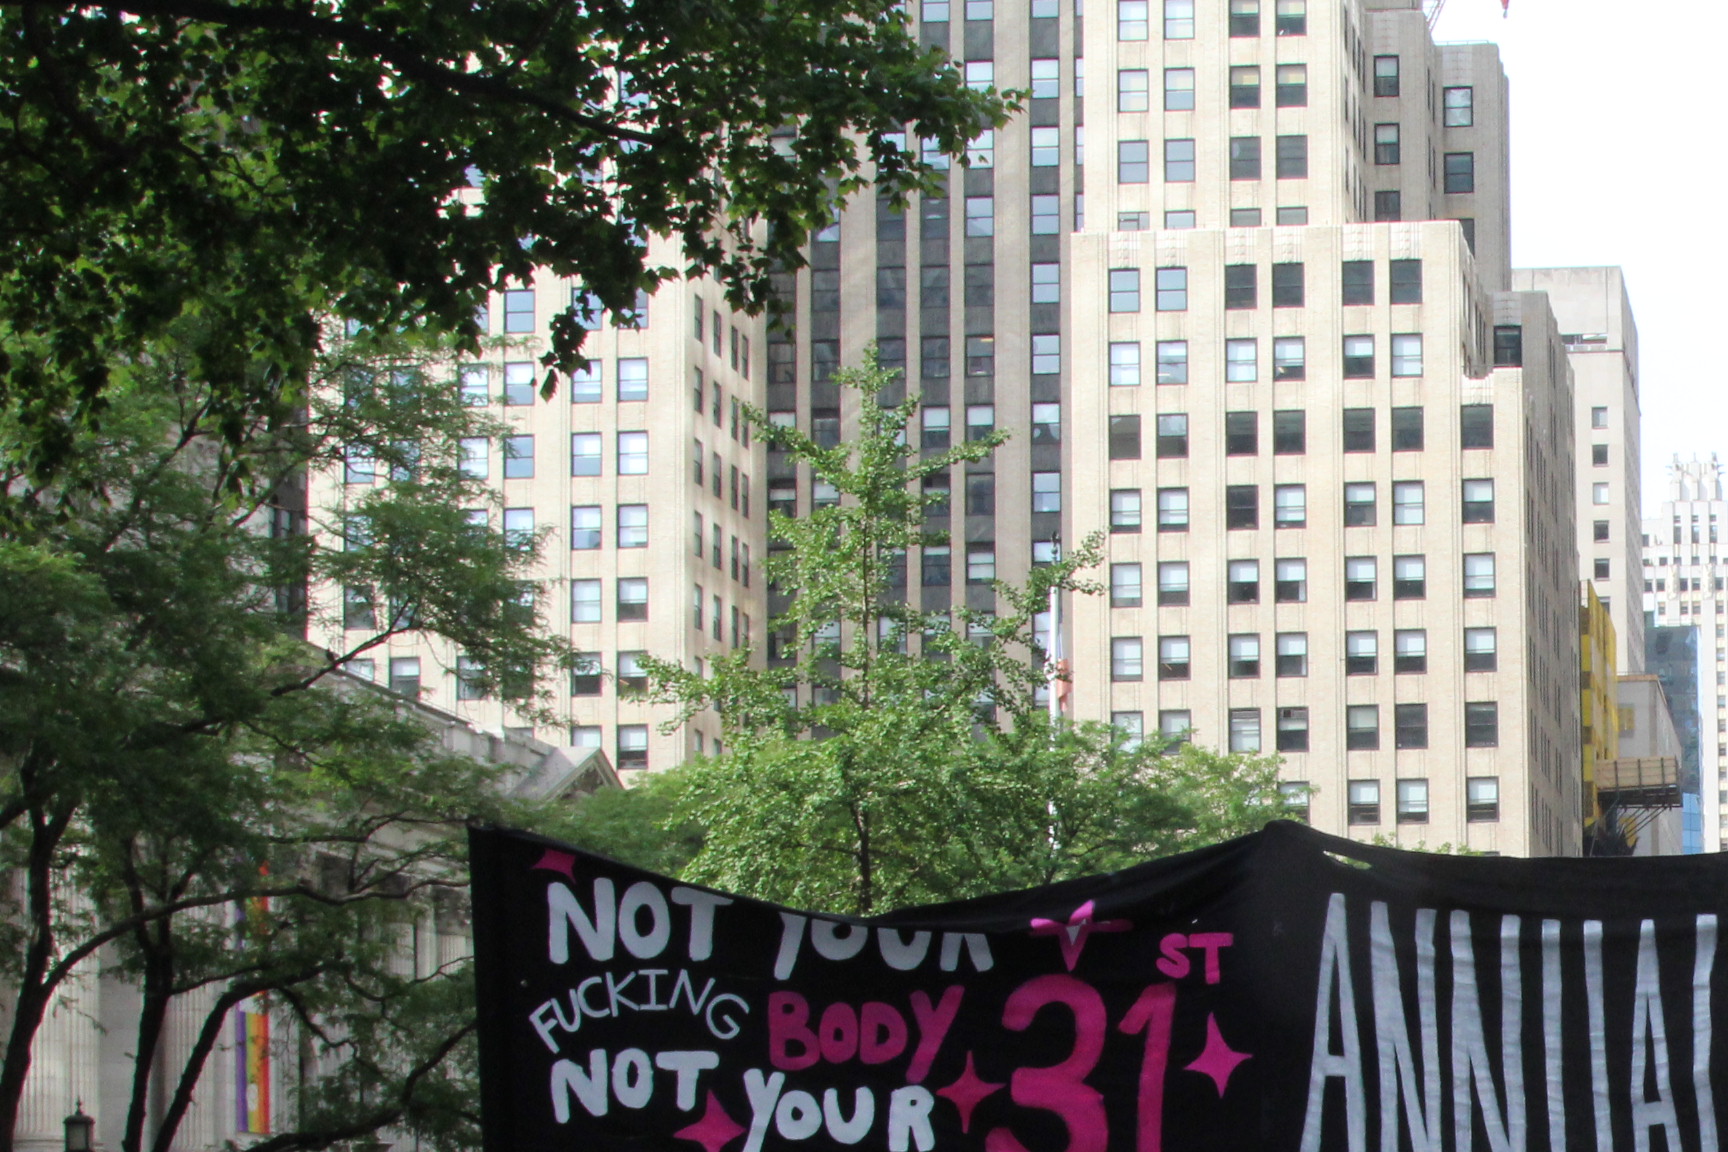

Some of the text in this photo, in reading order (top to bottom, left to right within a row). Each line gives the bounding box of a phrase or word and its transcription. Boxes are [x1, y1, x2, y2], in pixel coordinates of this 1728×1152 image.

[547, 877, 733, 964] NOT
[1155, 932, 1233, 984] ST
[529, 968, 749, 1054] FUCKING
[767, 984, 966, 1083] BODY
[550, 1048, 720, 1124] NOT
